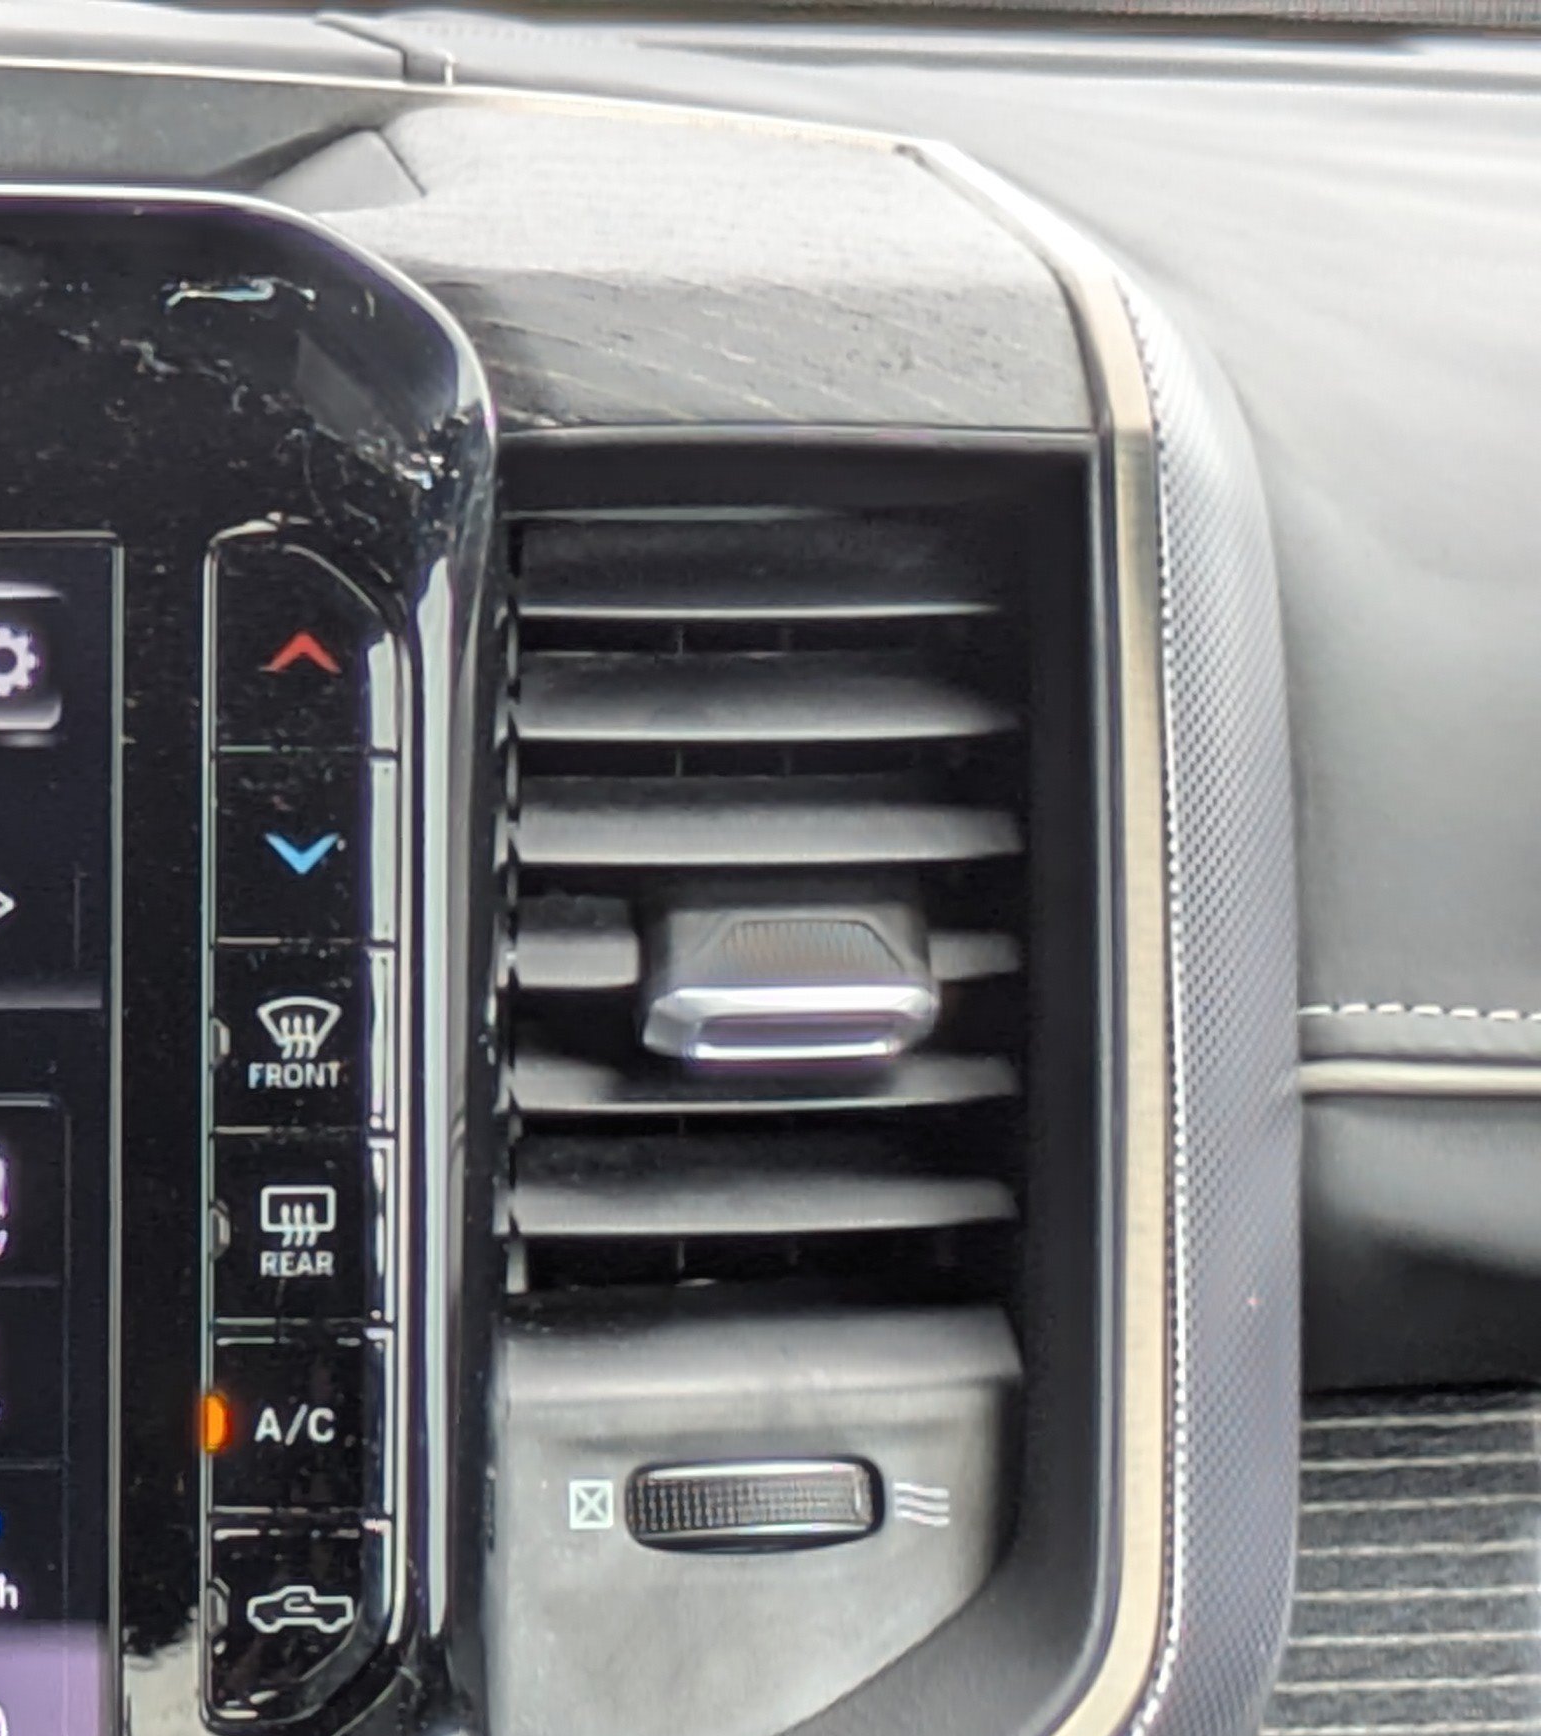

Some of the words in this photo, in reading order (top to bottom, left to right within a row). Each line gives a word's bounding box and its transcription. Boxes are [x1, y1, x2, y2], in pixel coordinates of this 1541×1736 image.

[249, 1062, 340, 1089] FRONT
[261, 1251, 334, 1276] REAR
[255, 1407, 335, 1443] A/C
